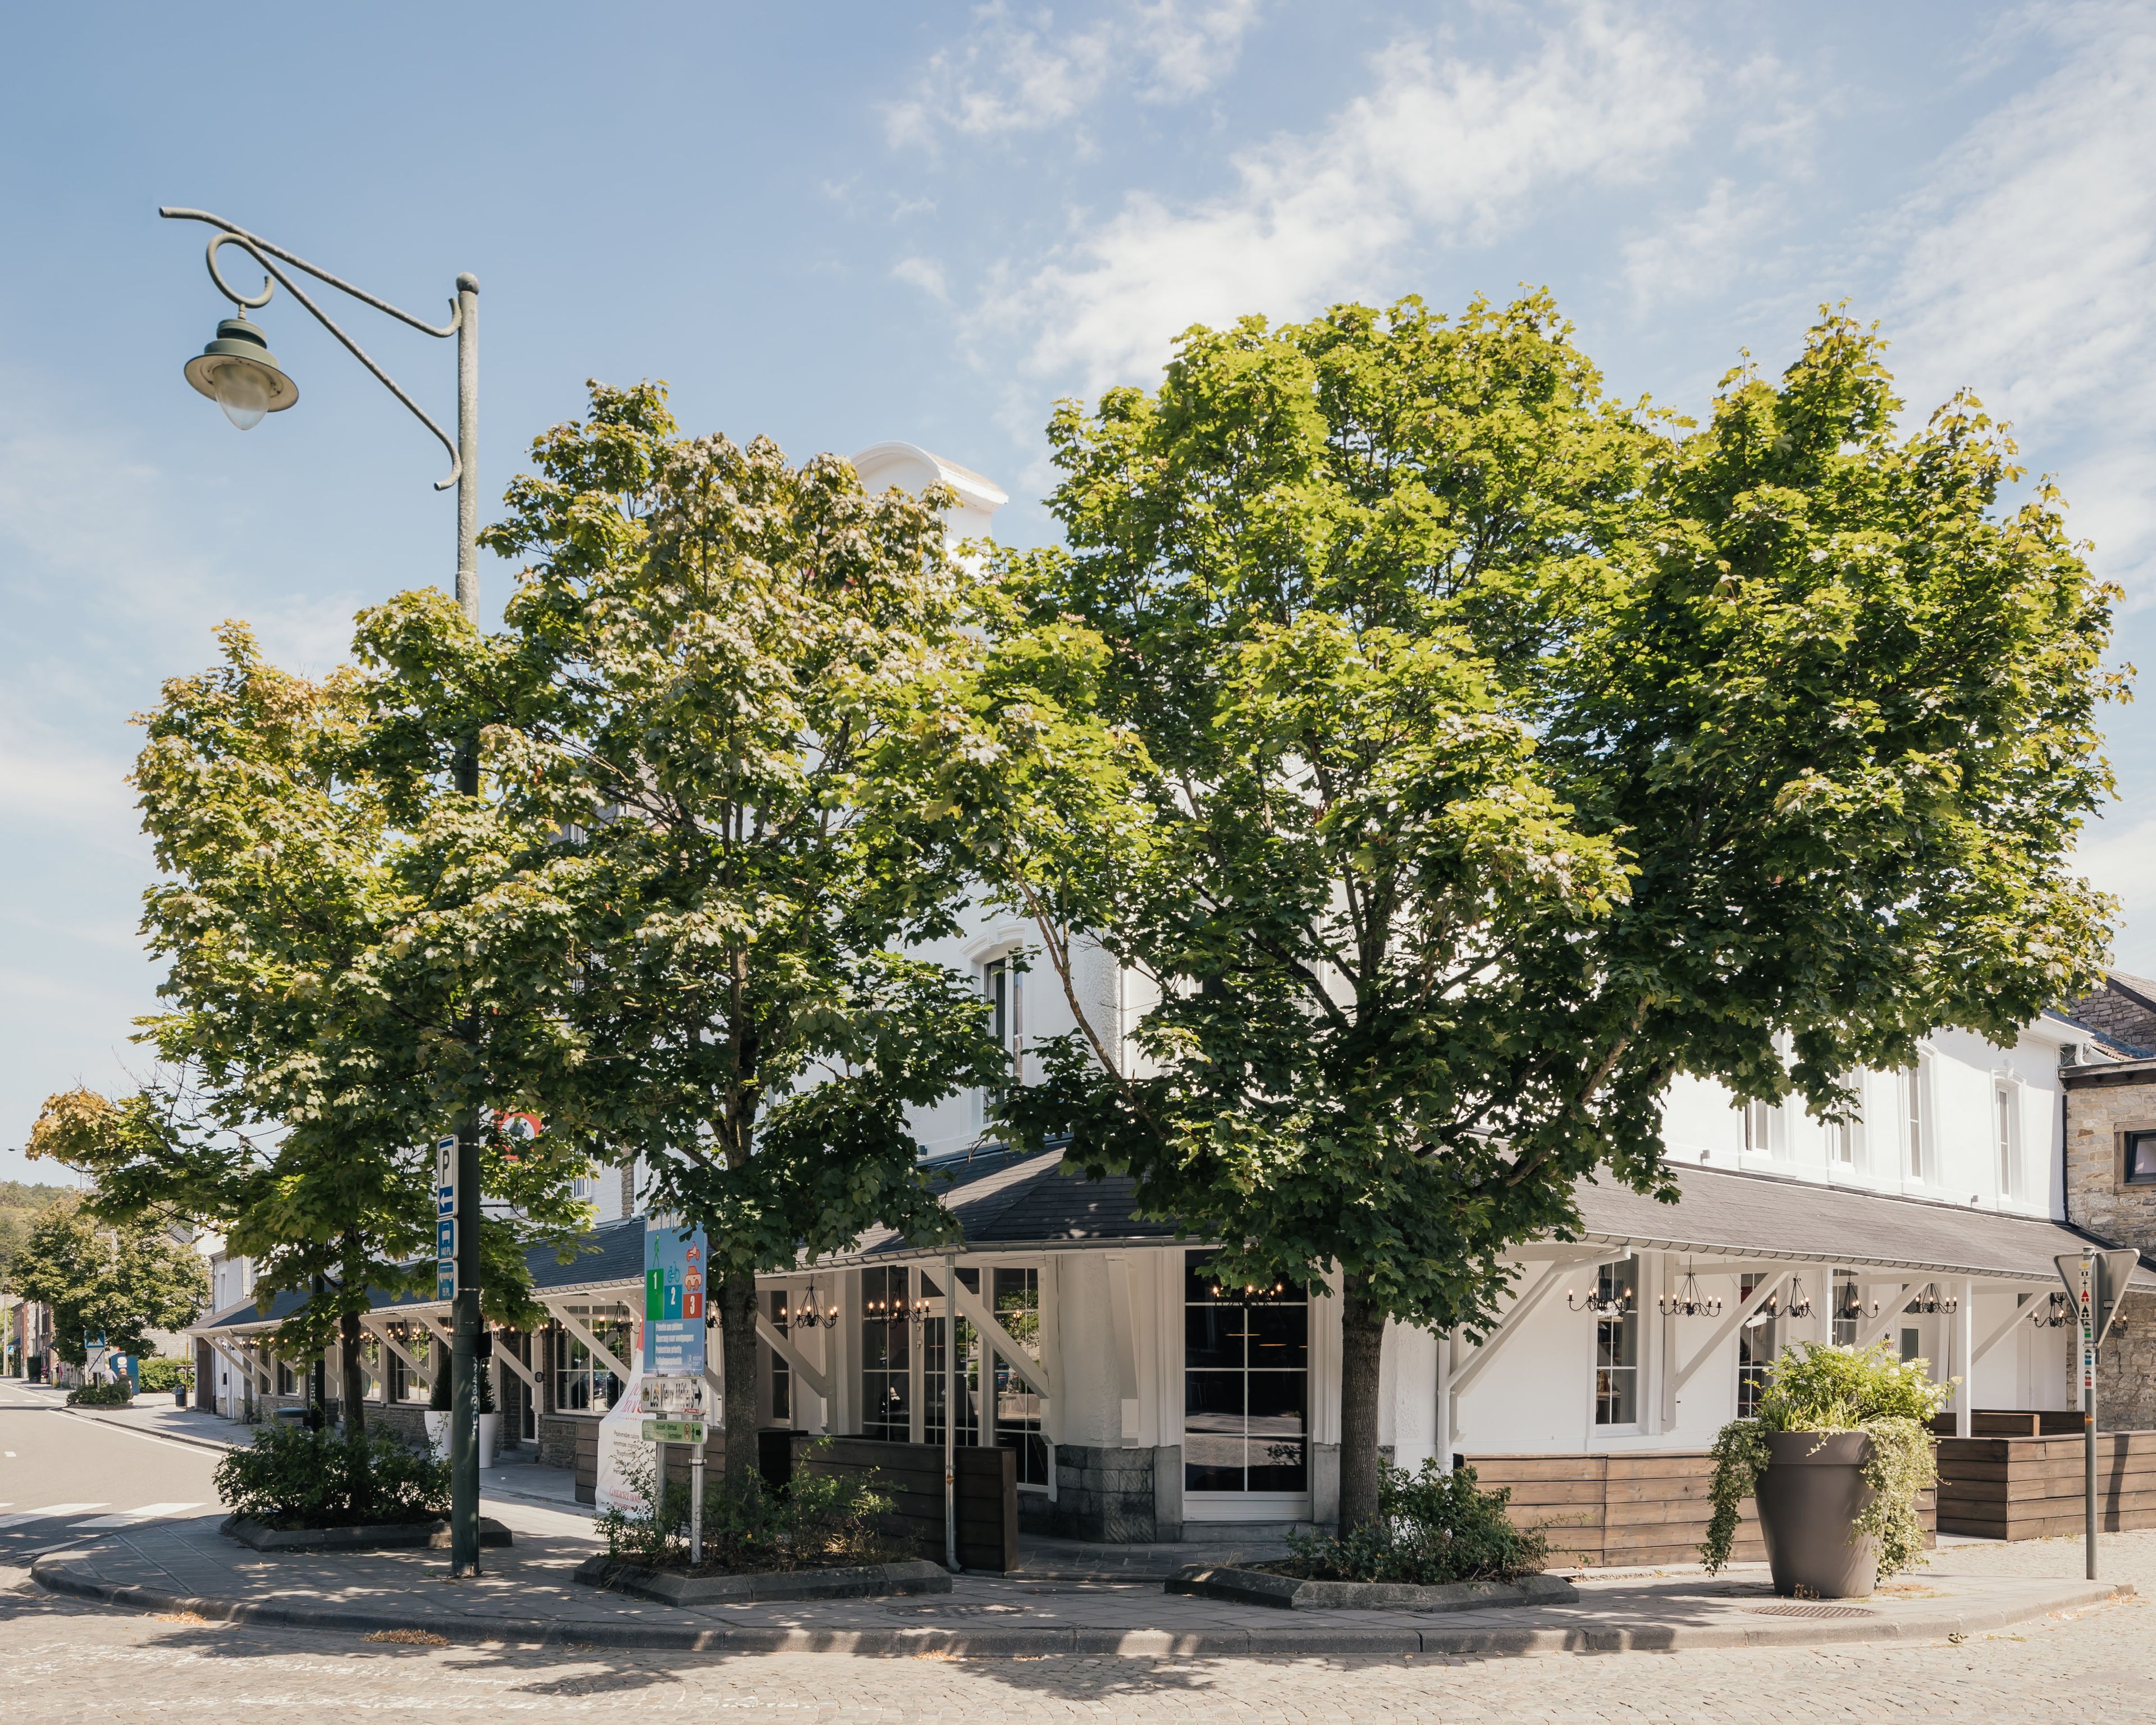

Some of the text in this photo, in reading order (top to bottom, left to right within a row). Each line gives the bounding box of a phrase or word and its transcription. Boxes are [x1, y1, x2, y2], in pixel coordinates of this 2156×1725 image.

[442, 1149, 450, 1185] P
[653, 1272, 657, 1289] 1
[671, 1286, 676, 1305] 2
[689, 1295, 695, 1315] 3
[650, 1383, 659, 1408] Les
